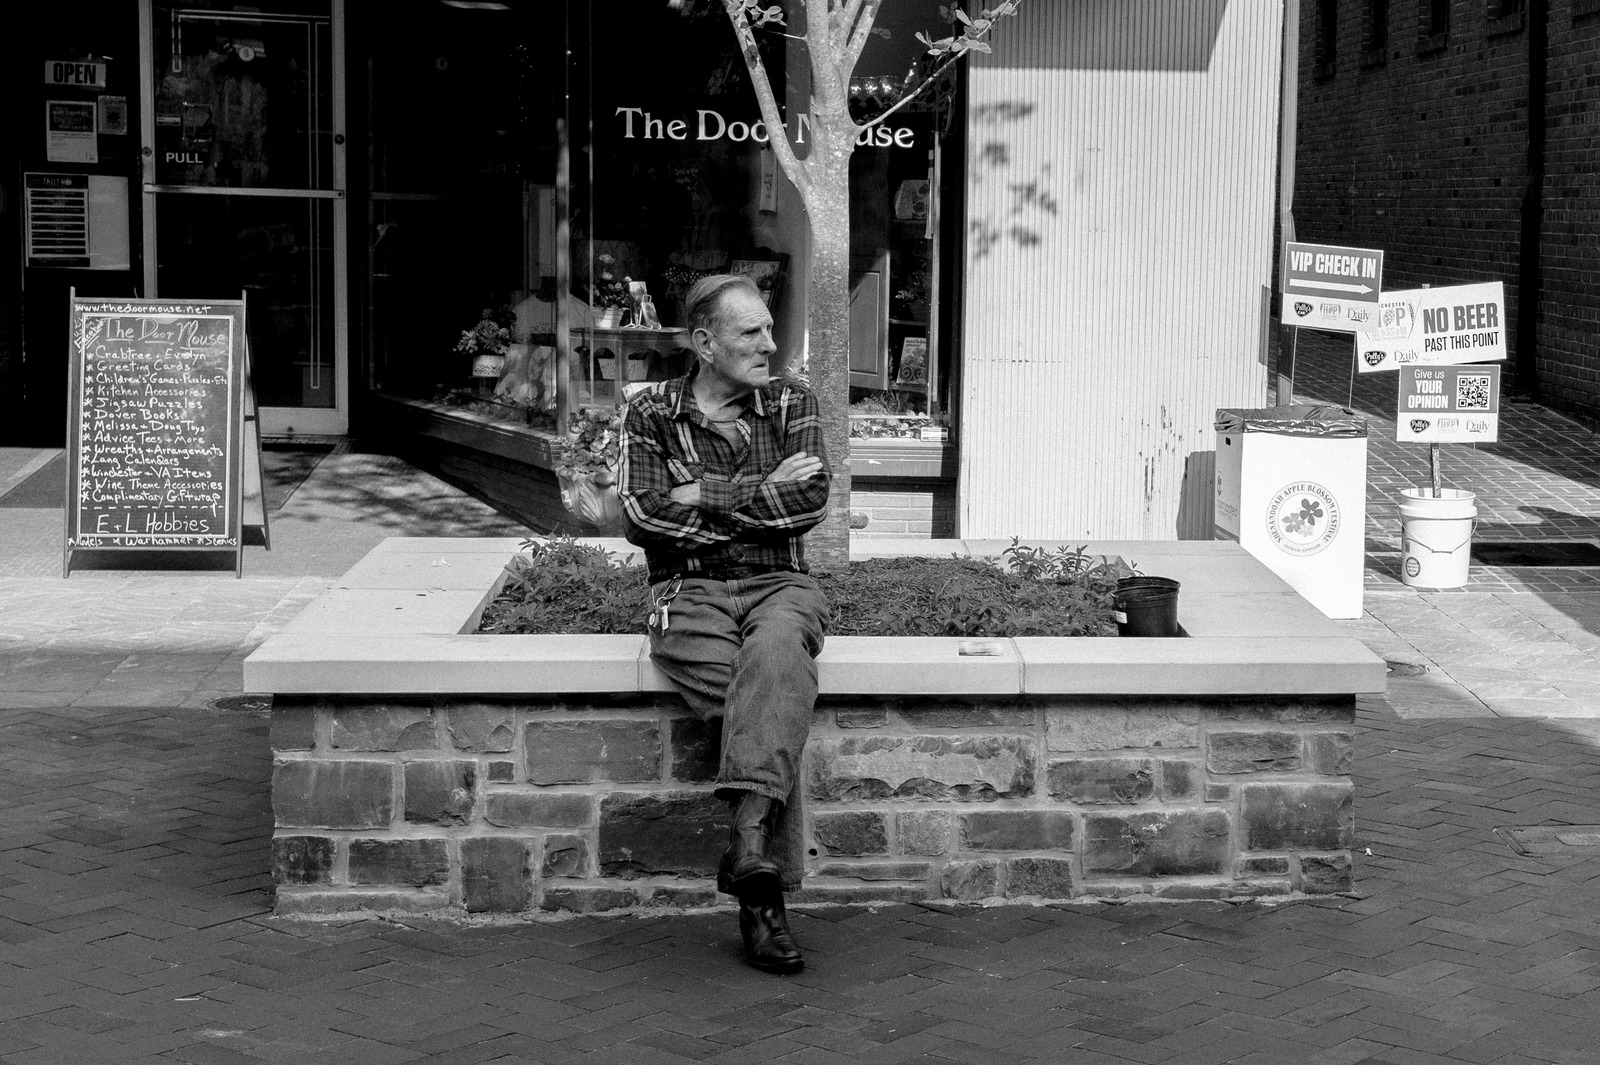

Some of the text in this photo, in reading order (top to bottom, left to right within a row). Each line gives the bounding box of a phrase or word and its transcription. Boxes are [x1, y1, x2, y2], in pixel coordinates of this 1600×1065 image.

[53, 62, 97, 84] OPEN
[615, 107, 687, 141] The
[696, 109, 787, 143] Doo
[165, 152, 204, 164] PULL
[1290, 250, 1377, 279] VIP CHECK IN
[75, 304, 212, 314] www.thedoormouse.net
[1347, 308, 1371, 323] Daily
[1422, 302, 1499, 334] NO BEER
[101, 317, 227, 347] The Door Mouse
[1424, 336, 1448, 353] PAST
[1449, 334, 1471, 350] THIS
[1472, 331, 1499, 348] POINT
[95, 345, 152, 360] Crabtree
[1394, 349, 1420, 363] Daily
[96, 359, 192, 377] Greeting Cards
[1414, 368, 1445, 379] Give us
[97, 384, 207, 398] Kitchen Accessories
[1415, 380, 1443, 394] YOUR
[96, 397, 204, 412] Jigsaw Puzzles
[1408, 395, 1449, 409] OPINION
[94, 408, 180, 421] Dover Books
[94, 420, 139, 432] Melissa
[149, 420, 182, 434] Doug
[181, 420, 206, 435] Toys
[1466, 420, 1490, 433] Daily
[94, 431, 136, 443] Advice
[136, 431, 163, 445] Tees
[174, 435, 206, 445] More
[94, 444, 144, 455] Wreaths
[154, 444, 224, 459] Arrangements
[91, 454, 121, 470] Lang
[91, 465, 143, 478] Winchester
[150, 466, 172, 478] VA
[172, 467, 213, 478] Items
[94, 477, 223, 490] Wine Theme Accessories
[92, 489, 221, 506] Complimentary Giftwrap
[1282, 484, 1306, 497] APPLE
[1322, 509, 1338, 543] FESTIVAL
[96, 514, 110, 534] E
[125, 513, 138, 533] L
[146, 512, 210, 534] Hobbies
[125, 537, 193, 547] Warhammer
